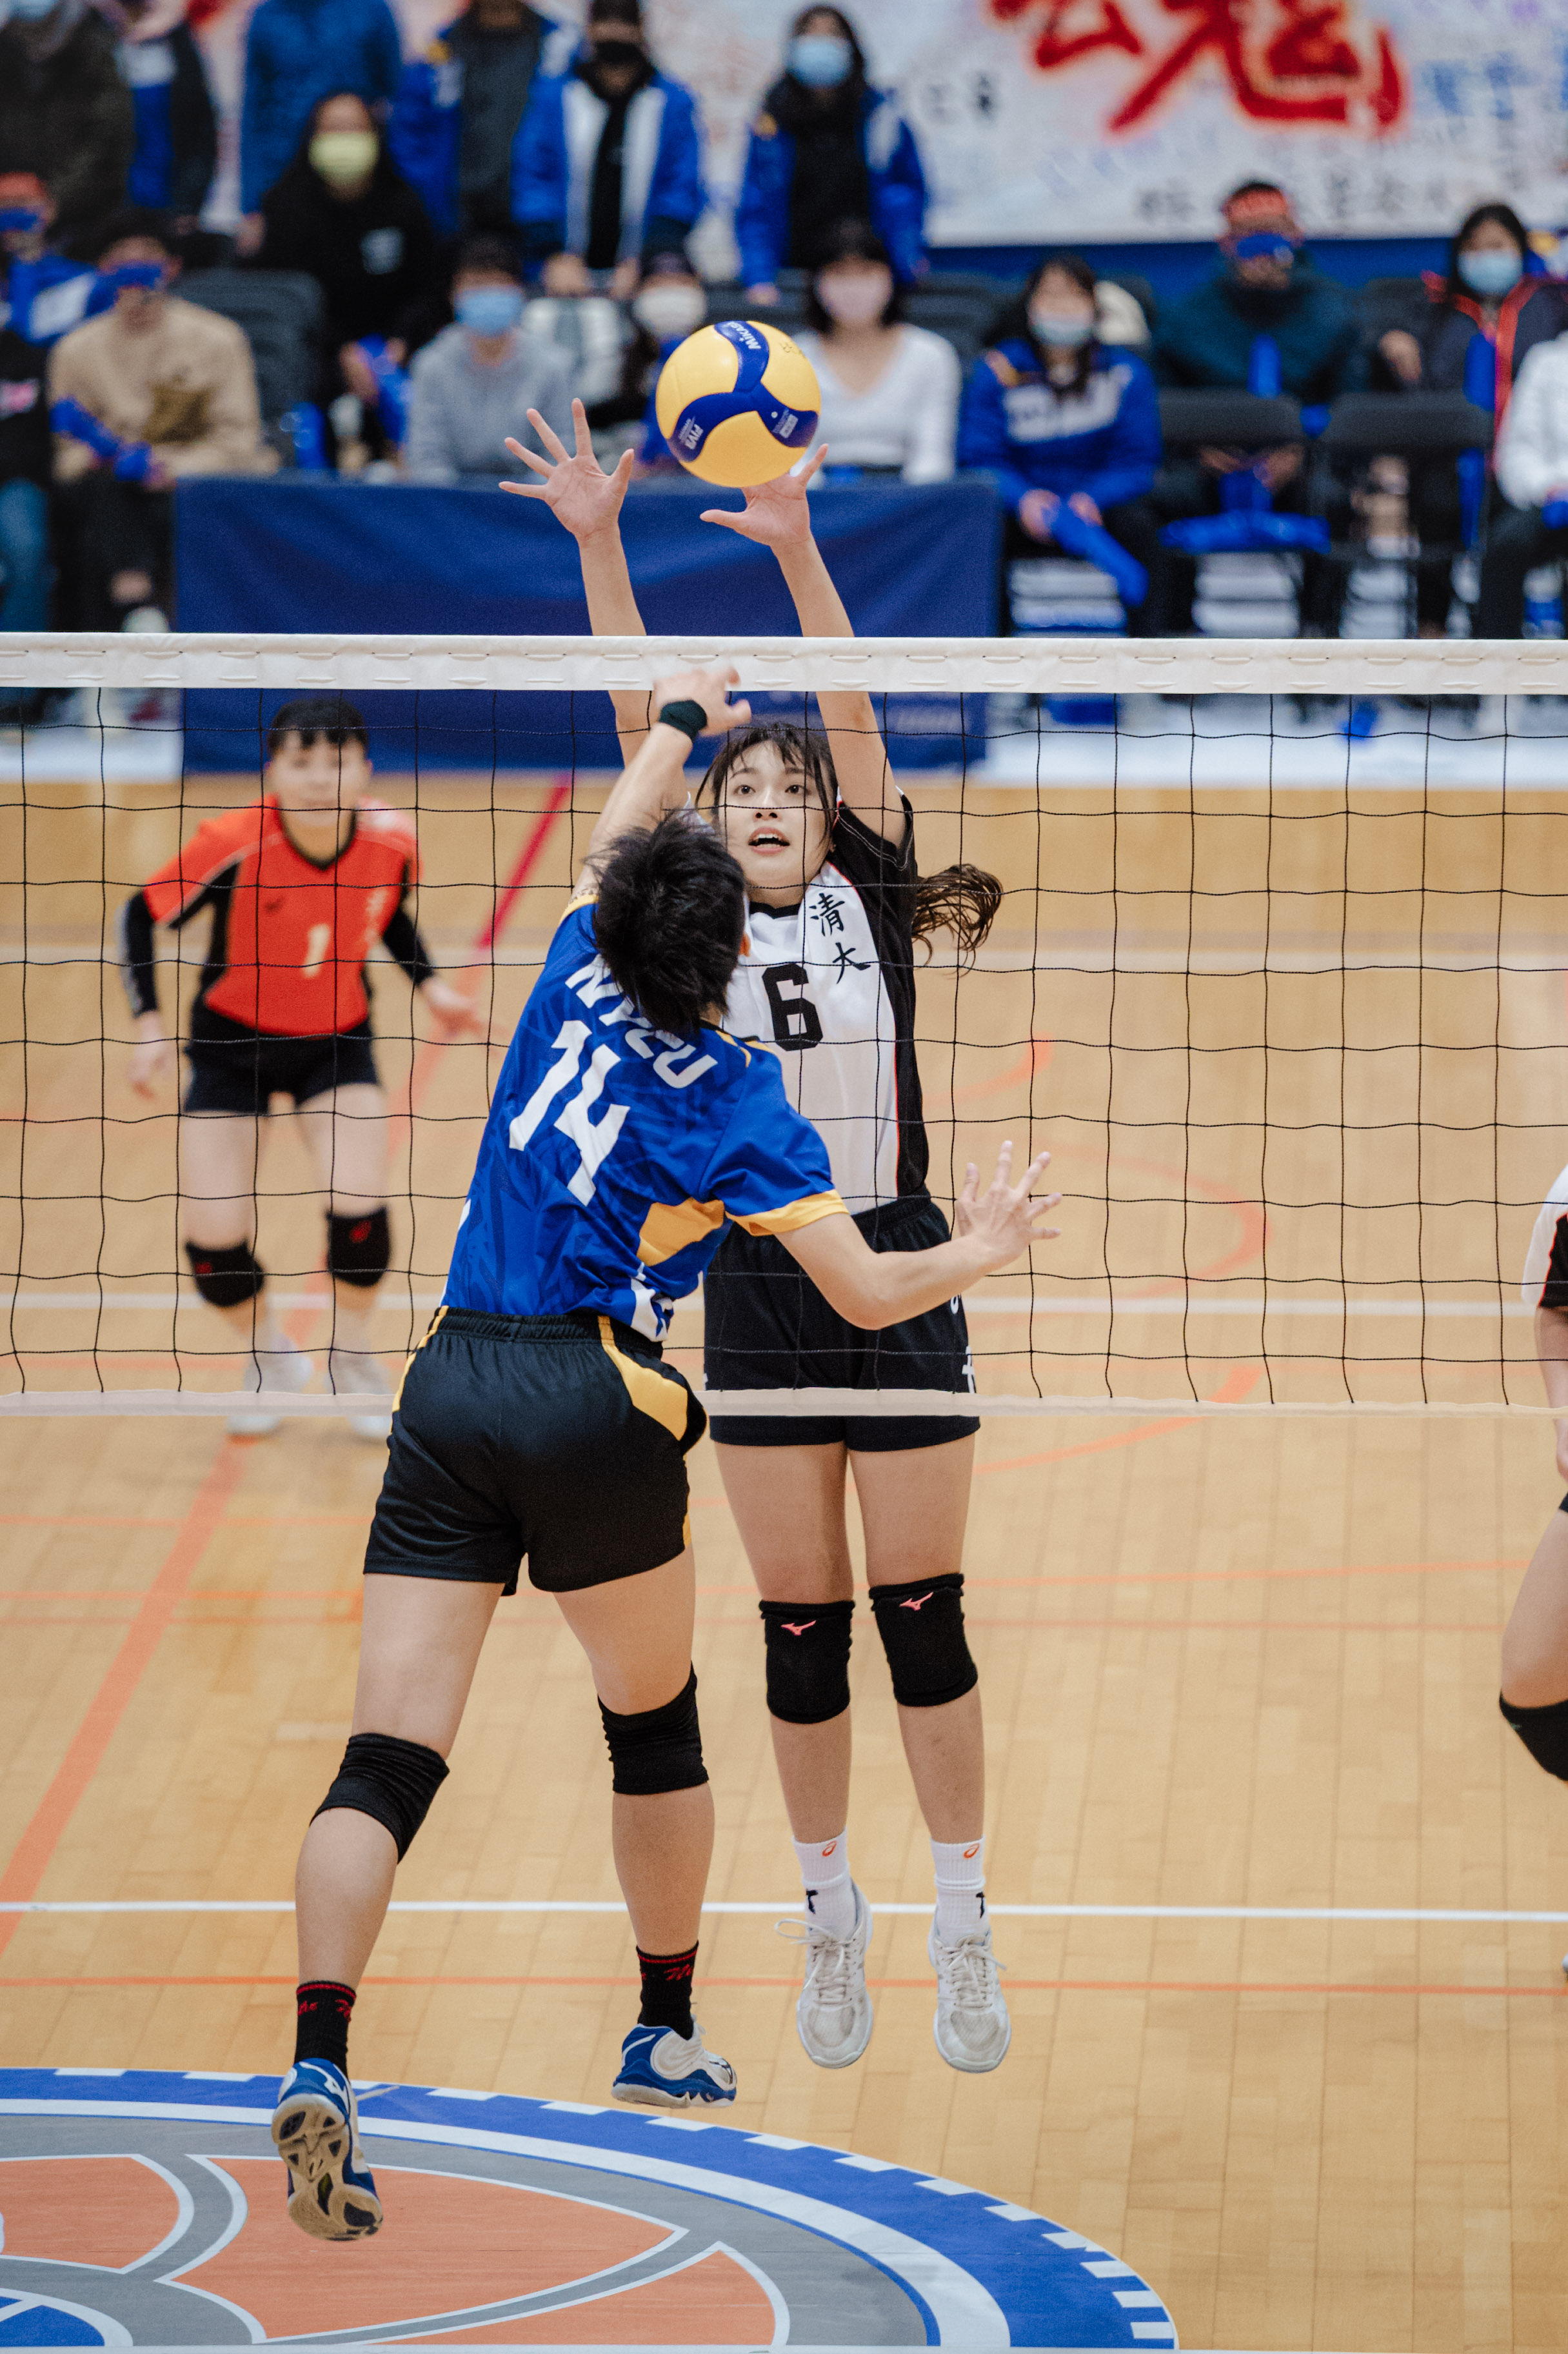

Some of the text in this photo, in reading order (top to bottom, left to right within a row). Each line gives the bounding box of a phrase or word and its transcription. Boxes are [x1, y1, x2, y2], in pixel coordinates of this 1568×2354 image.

[808, 892, 871, 984] 清大
[761, 963, 823, 1052] 6
[509, 1020, 631, 1207] 14
